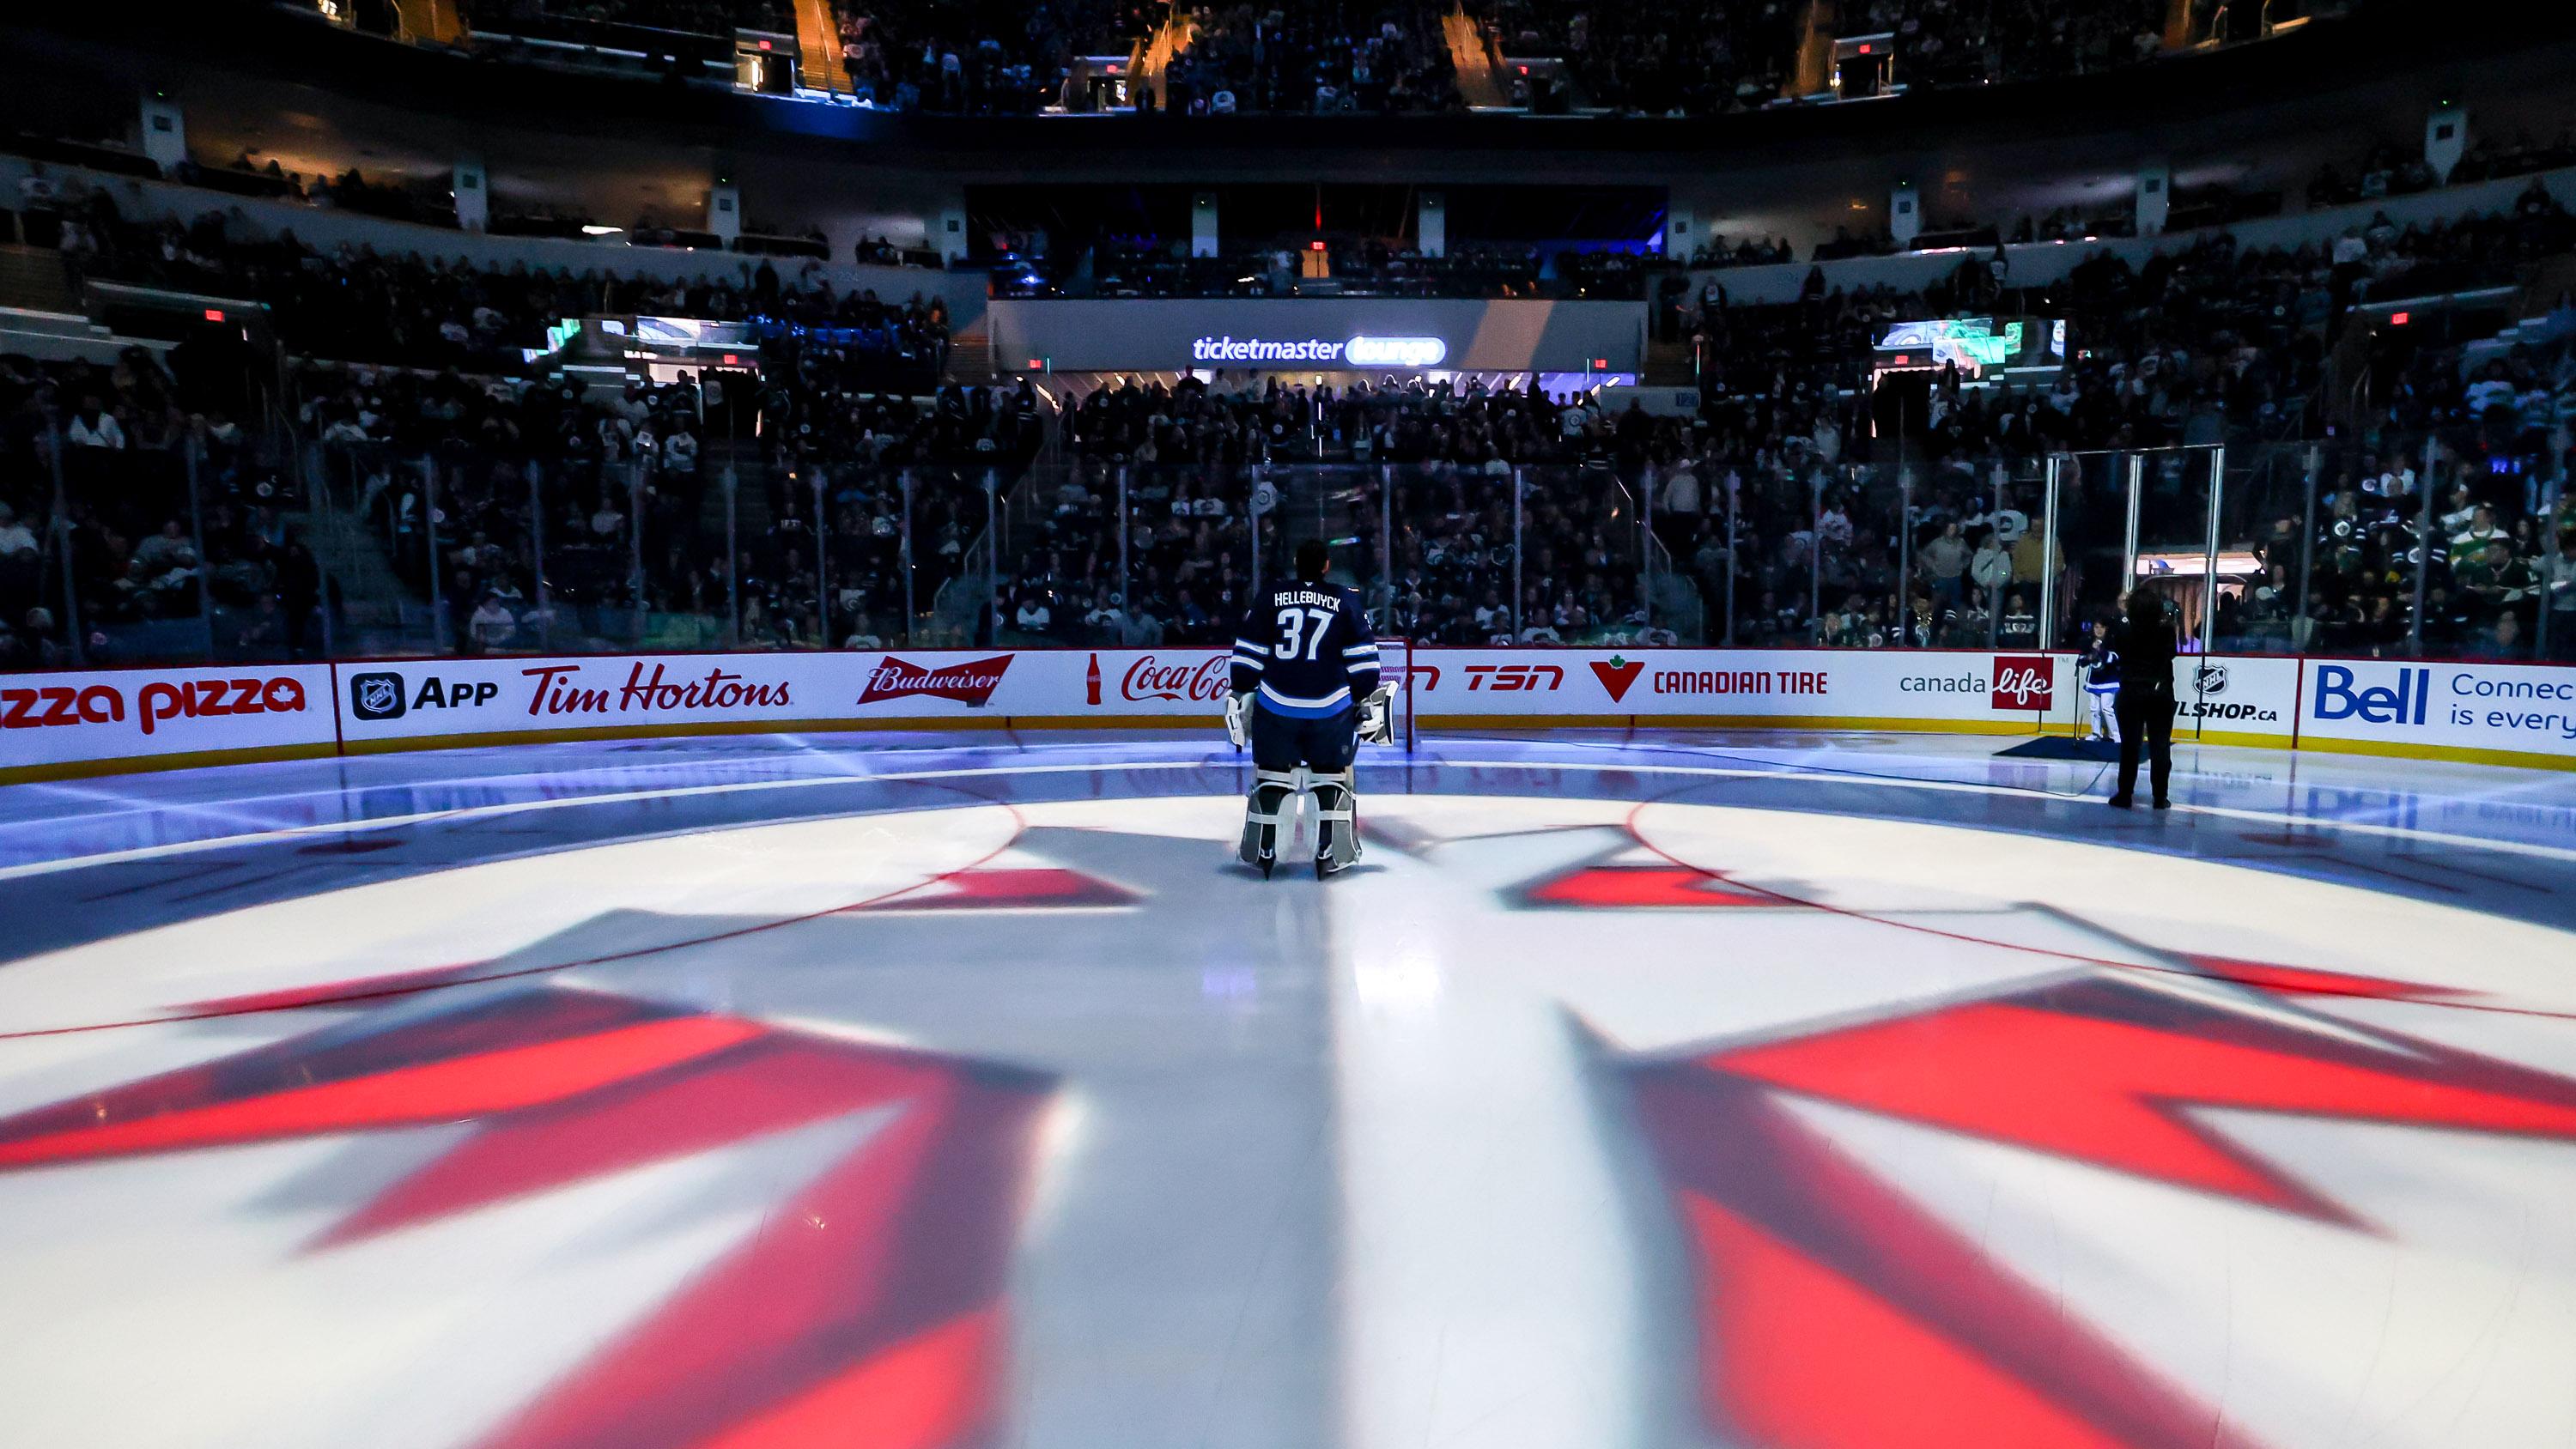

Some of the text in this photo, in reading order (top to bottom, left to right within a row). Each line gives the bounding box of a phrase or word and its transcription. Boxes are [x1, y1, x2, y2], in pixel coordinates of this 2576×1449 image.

[1193, 336, 1438, 366] ticketmaster lounge
[1274, 591, 1340, 612] HELLEBUYCK
[1275, 608, 1334, 660] 37
[521, 661, 790, 716] Tim Hortons
[867, 666, 1001, 692] Budweiser
[1121, 655, 1232, 701] Coca-Co
[1464, 664, 1564, 691] TSN
[1654, 671, 1828, 694] CANADIAN TIRE
[1899, 672, 1986, 693] canada
[1992, 667, 2052, 706] life
[0, 677, 306, 735] zza pizza
[2314, 664, 2430, 725] Bell
[2175, 700, 2277, 722] LSHOP.CA
[2451, 704, 2474, 725] is
